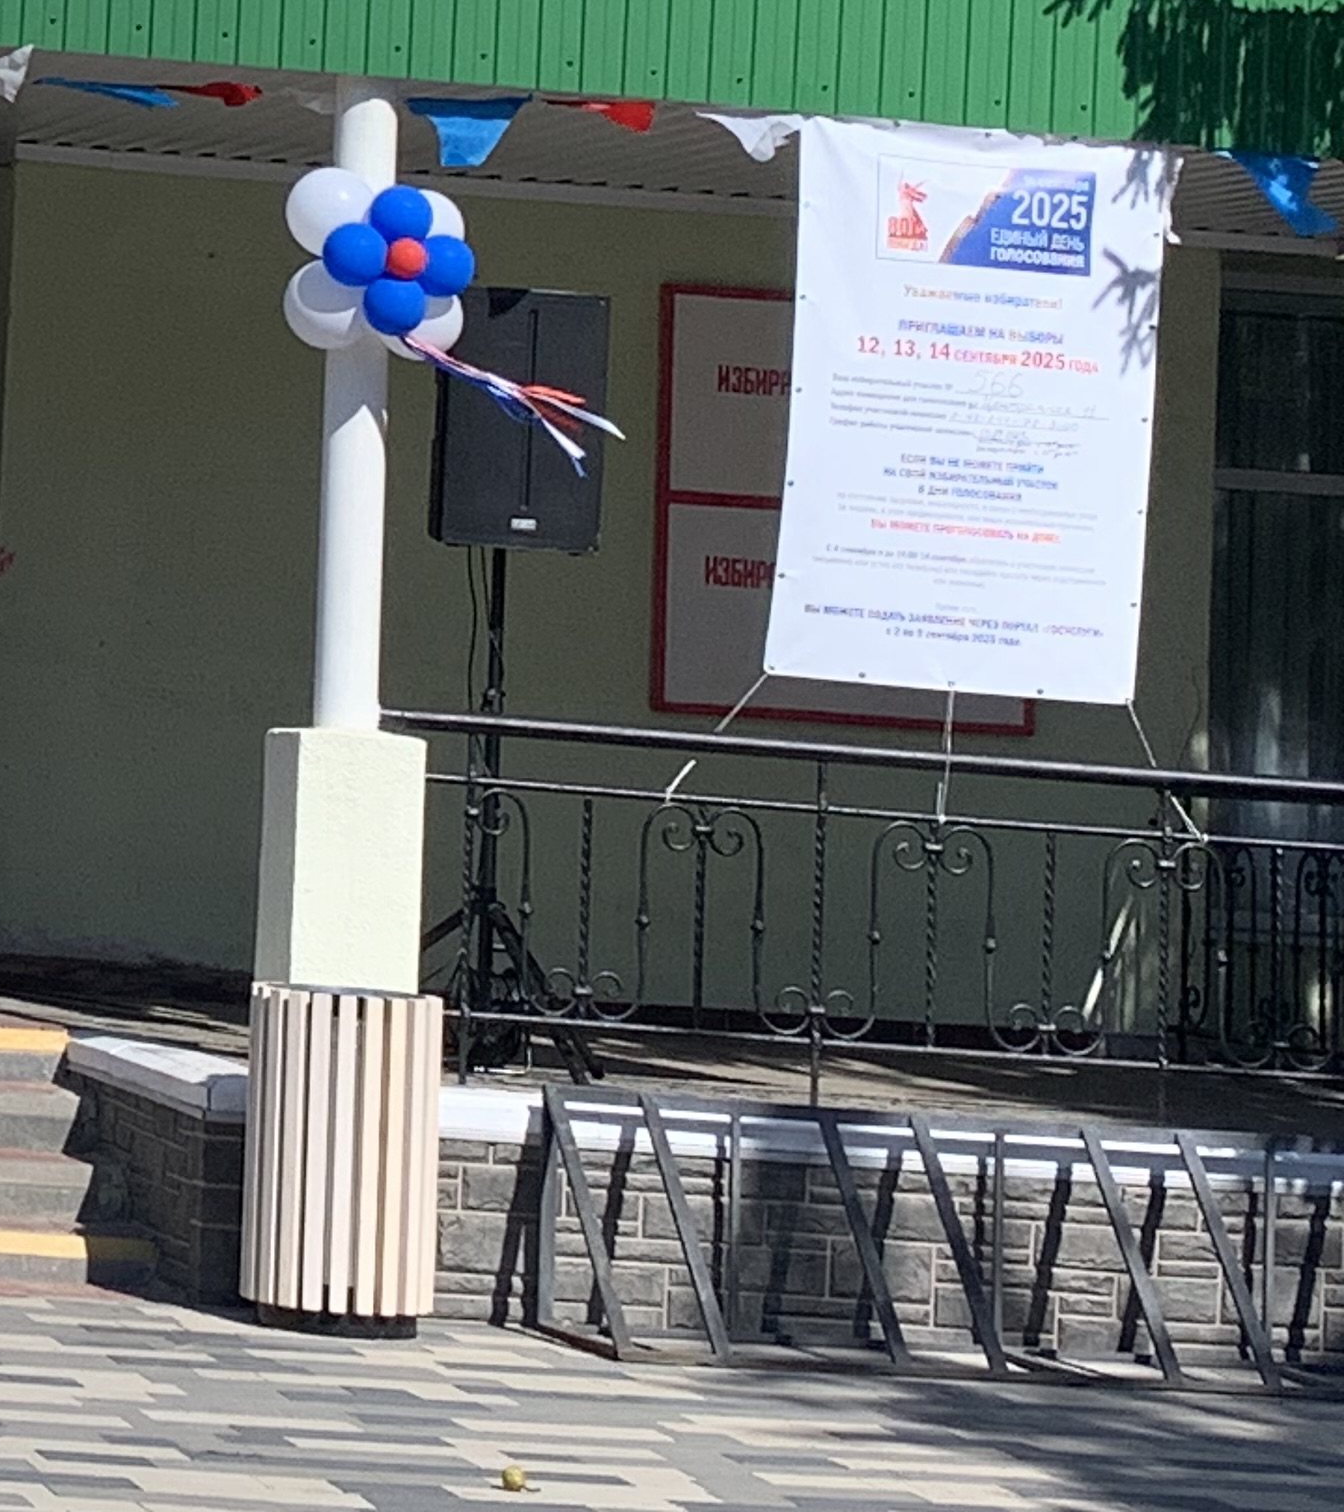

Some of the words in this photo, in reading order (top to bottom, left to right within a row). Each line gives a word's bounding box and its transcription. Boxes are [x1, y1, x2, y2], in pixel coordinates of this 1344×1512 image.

[1012, 191, 1090, 231] 2025
[990, 227, 1048, 251] ЕДИНЫЙ
[1050, 232, 1086, 253] ДЕНЬ
[857, 335, 885, 358] 12,
[894, 339, 922, 361] 13,
[929, 342, 951, 361] 14
[1020, 350, 1066, 370] 2025
